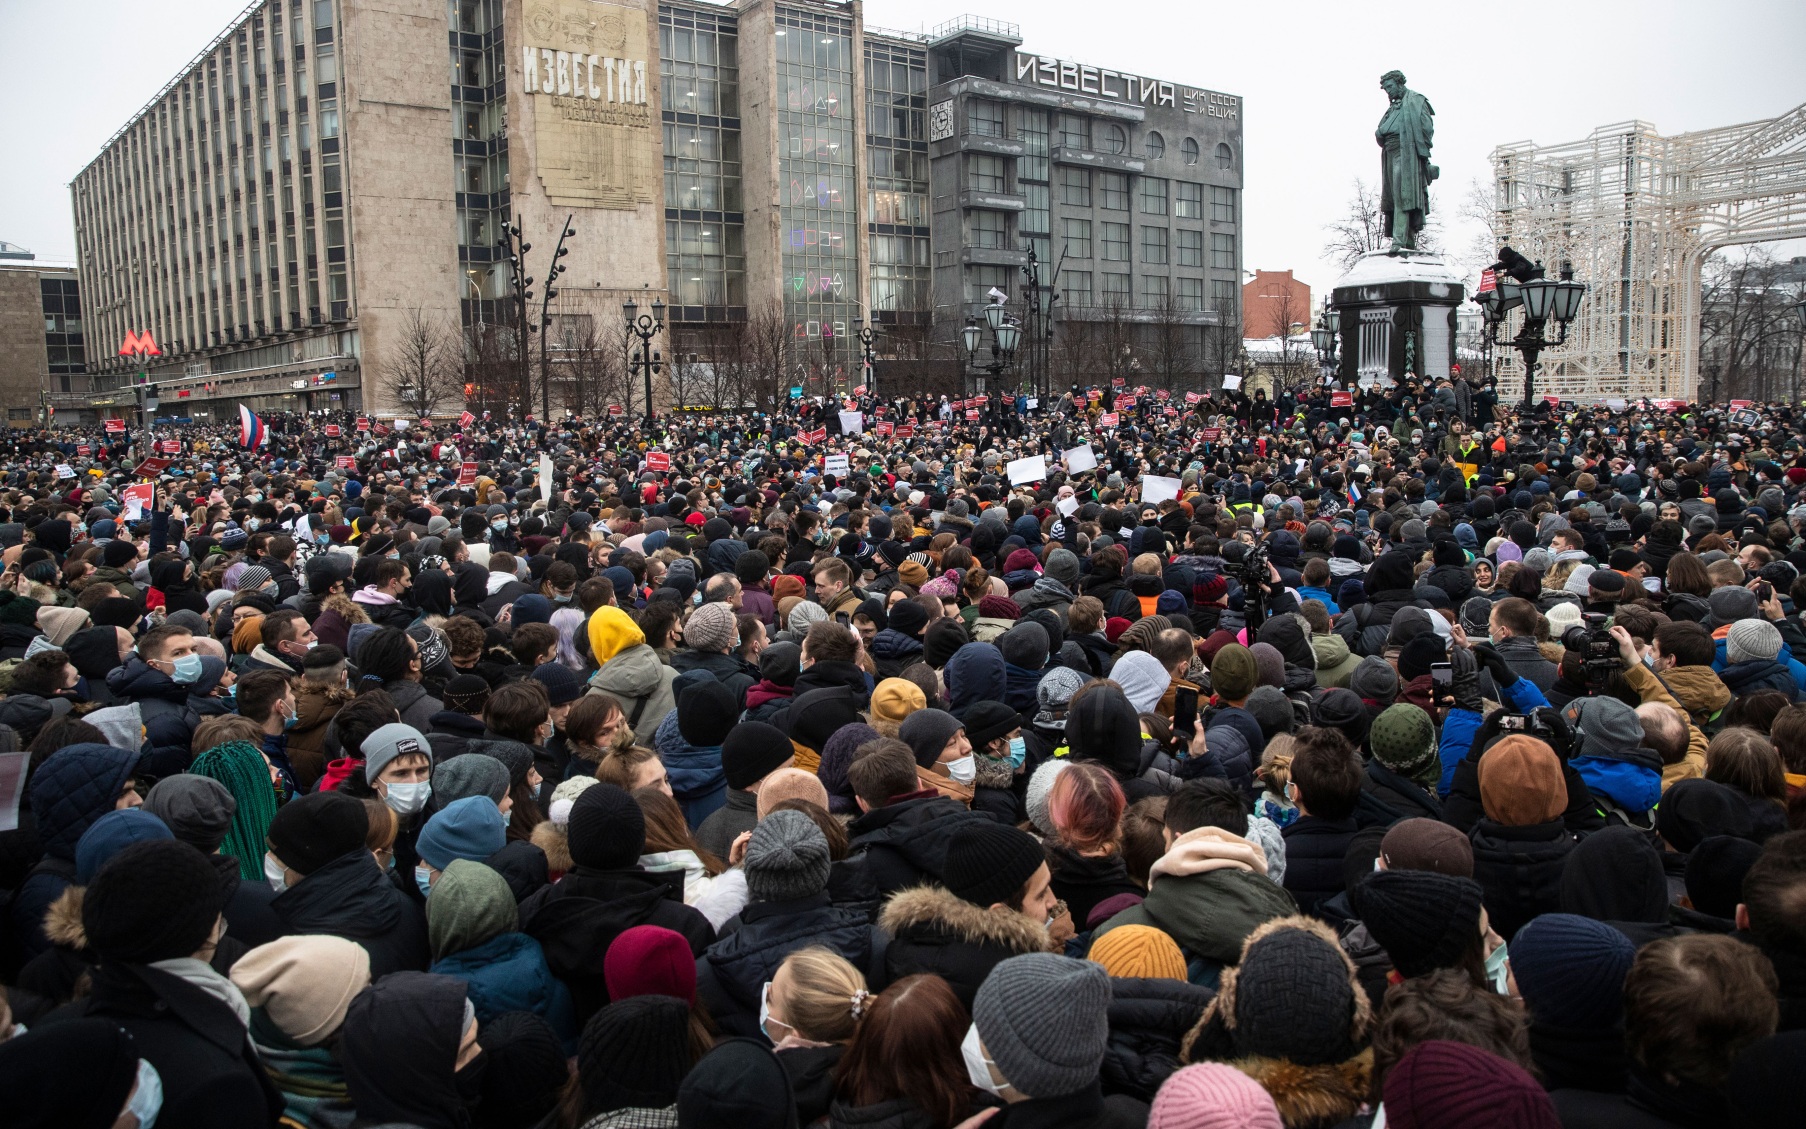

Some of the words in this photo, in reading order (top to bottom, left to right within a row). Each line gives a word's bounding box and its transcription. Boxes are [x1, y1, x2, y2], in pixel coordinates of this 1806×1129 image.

[523, 46, 646, 105] ИЗВЕСТИЯ
[1017, 53, 1175, 107] ИЗВЕСТИЯ
[552, 96, 597, 111] СОВЕТОВ
[1183, 87, 1206, 102] ЦИК
[1210, 93, 1237, 106] СССР
[1208, 105, 1237, 120] ВЦИК
